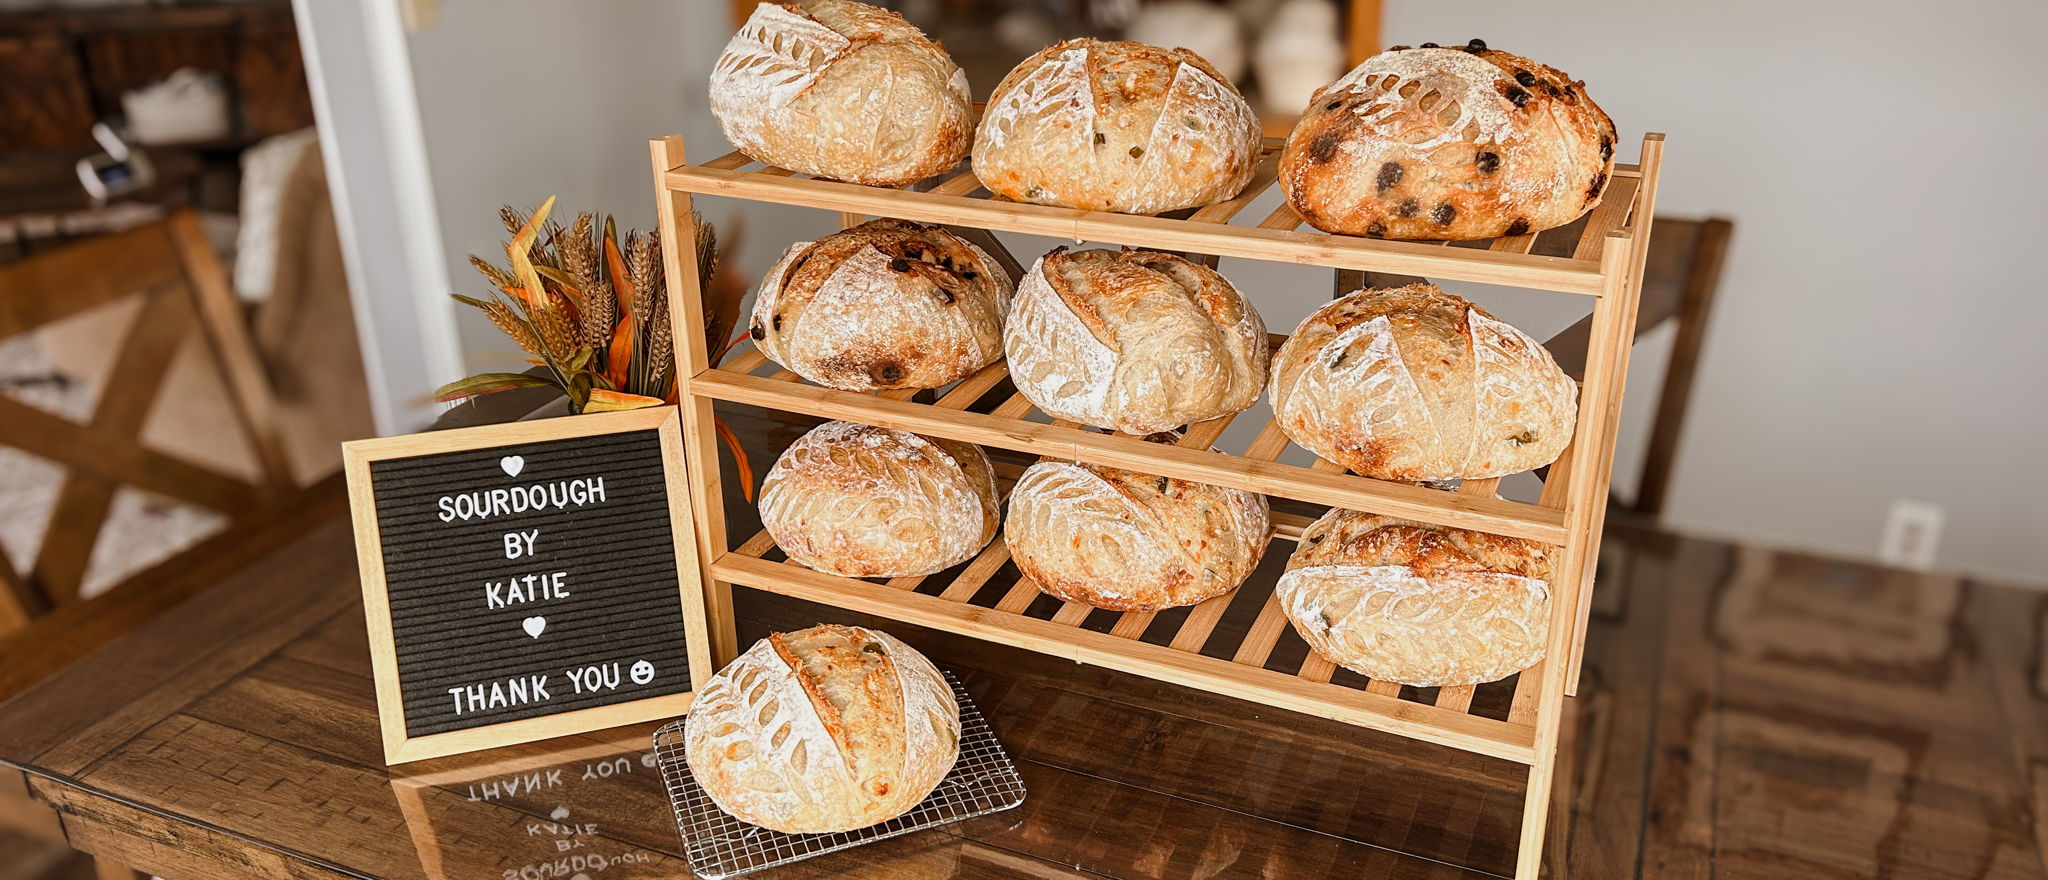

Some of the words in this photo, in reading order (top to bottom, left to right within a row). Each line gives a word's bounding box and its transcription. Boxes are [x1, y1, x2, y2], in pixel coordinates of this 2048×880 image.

[438, 476, 606, 522] SOURDOUGH
[503, 529, 539, 559] BY
[485, 572, 570, 609] KATIE
[449, 676, 550, 715] THANK
[566, 662, 621, 693] YOU
